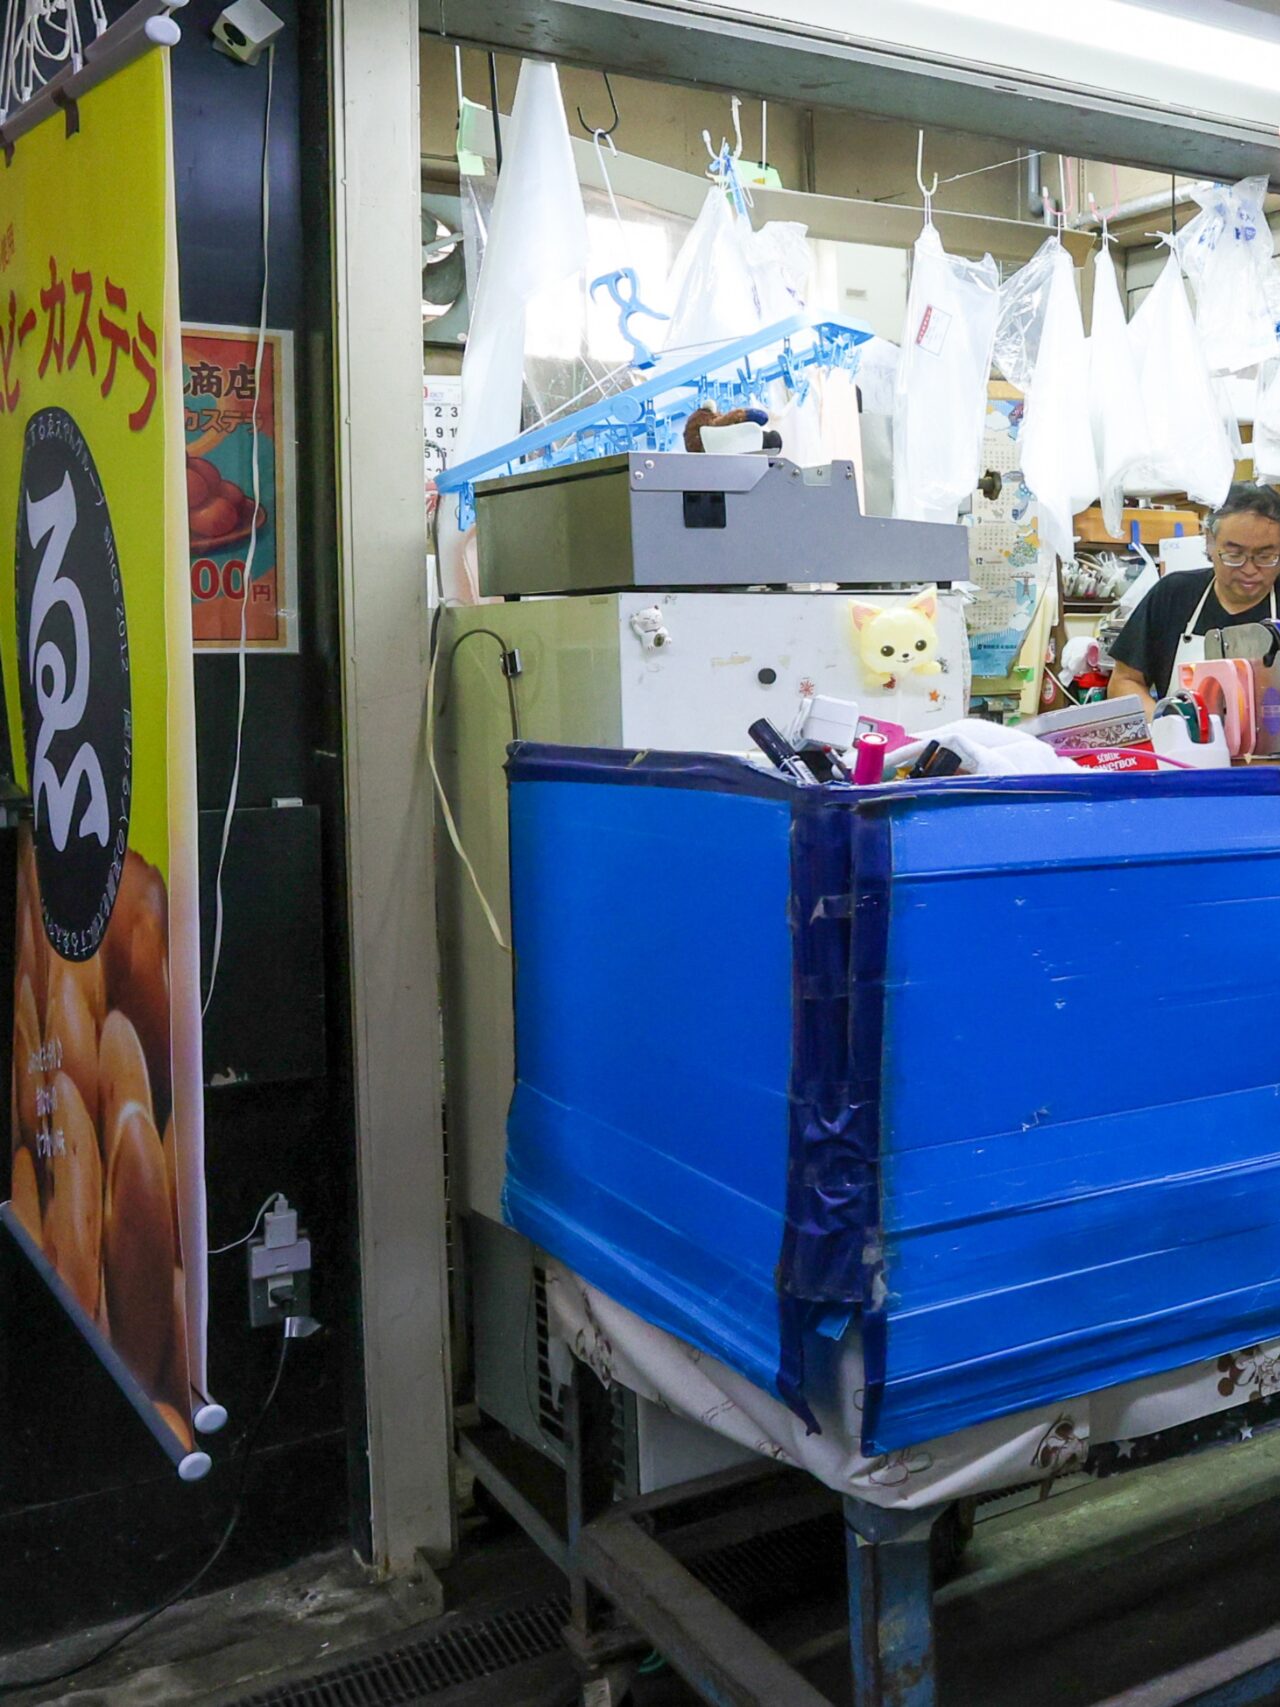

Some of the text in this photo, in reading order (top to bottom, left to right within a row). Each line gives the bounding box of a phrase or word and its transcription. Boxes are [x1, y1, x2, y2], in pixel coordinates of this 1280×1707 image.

[0, 255, 158, 432] ビーカステラ
[184, 361, 258, 400] 商店
